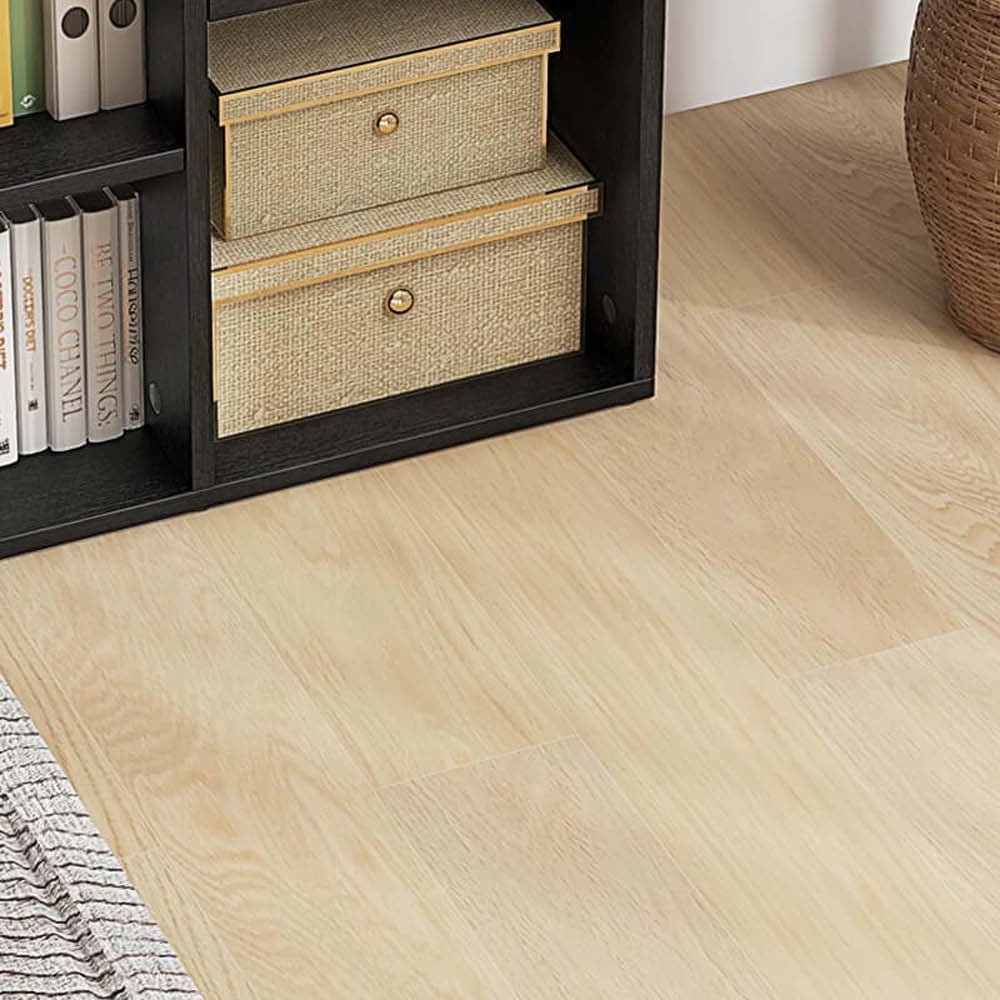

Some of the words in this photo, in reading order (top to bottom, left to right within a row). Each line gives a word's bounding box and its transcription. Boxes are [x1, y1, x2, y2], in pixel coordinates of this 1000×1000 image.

[94, 273, 115, 330] TWO
[57, 329, 83, 424] CHANEL
[96, 334, 119, 428] THINGS:
